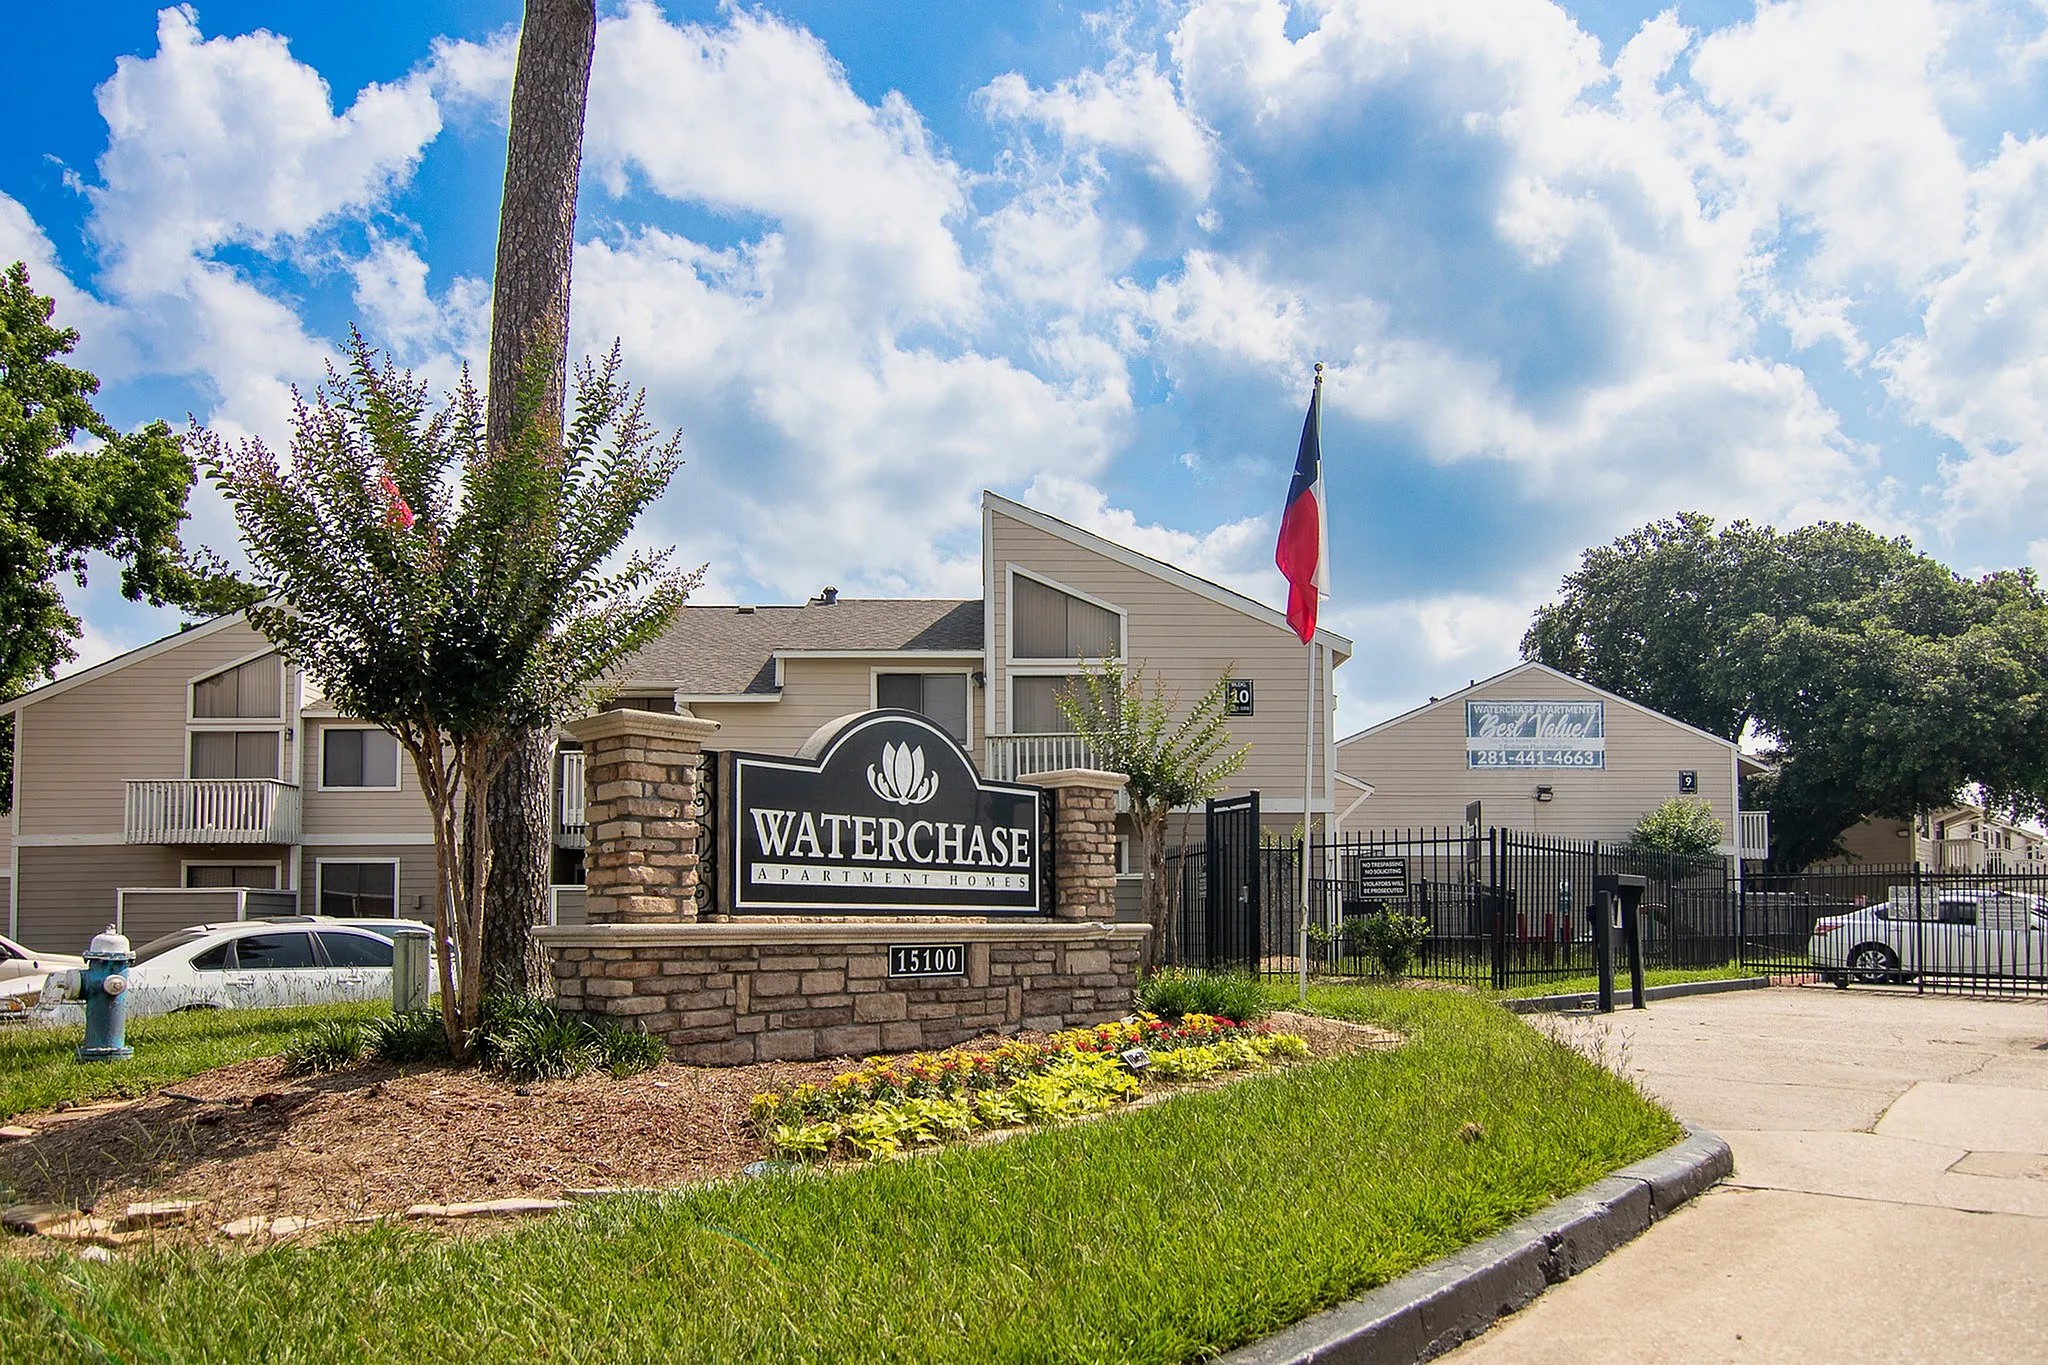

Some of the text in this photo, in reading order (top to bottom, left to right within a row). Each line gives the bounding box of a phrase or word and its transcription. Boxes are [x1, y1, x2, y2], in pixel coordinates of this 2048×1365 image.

[1230, 689, 1249, 703] 10
[1473, 704, 1596, 714] WATERCHASE APARTMENTS
[1478, 713, 1595, 739] Best Value!
[1477, 750, 1594, 765] 281-441-4663
[1685, 776, 1692, 786] 9
[750, 808, 1031, 868] WATERCHASE
[757, 867, 1026, 888] APARTMENT HOMES
[898, 948, 956, 972] 15100
